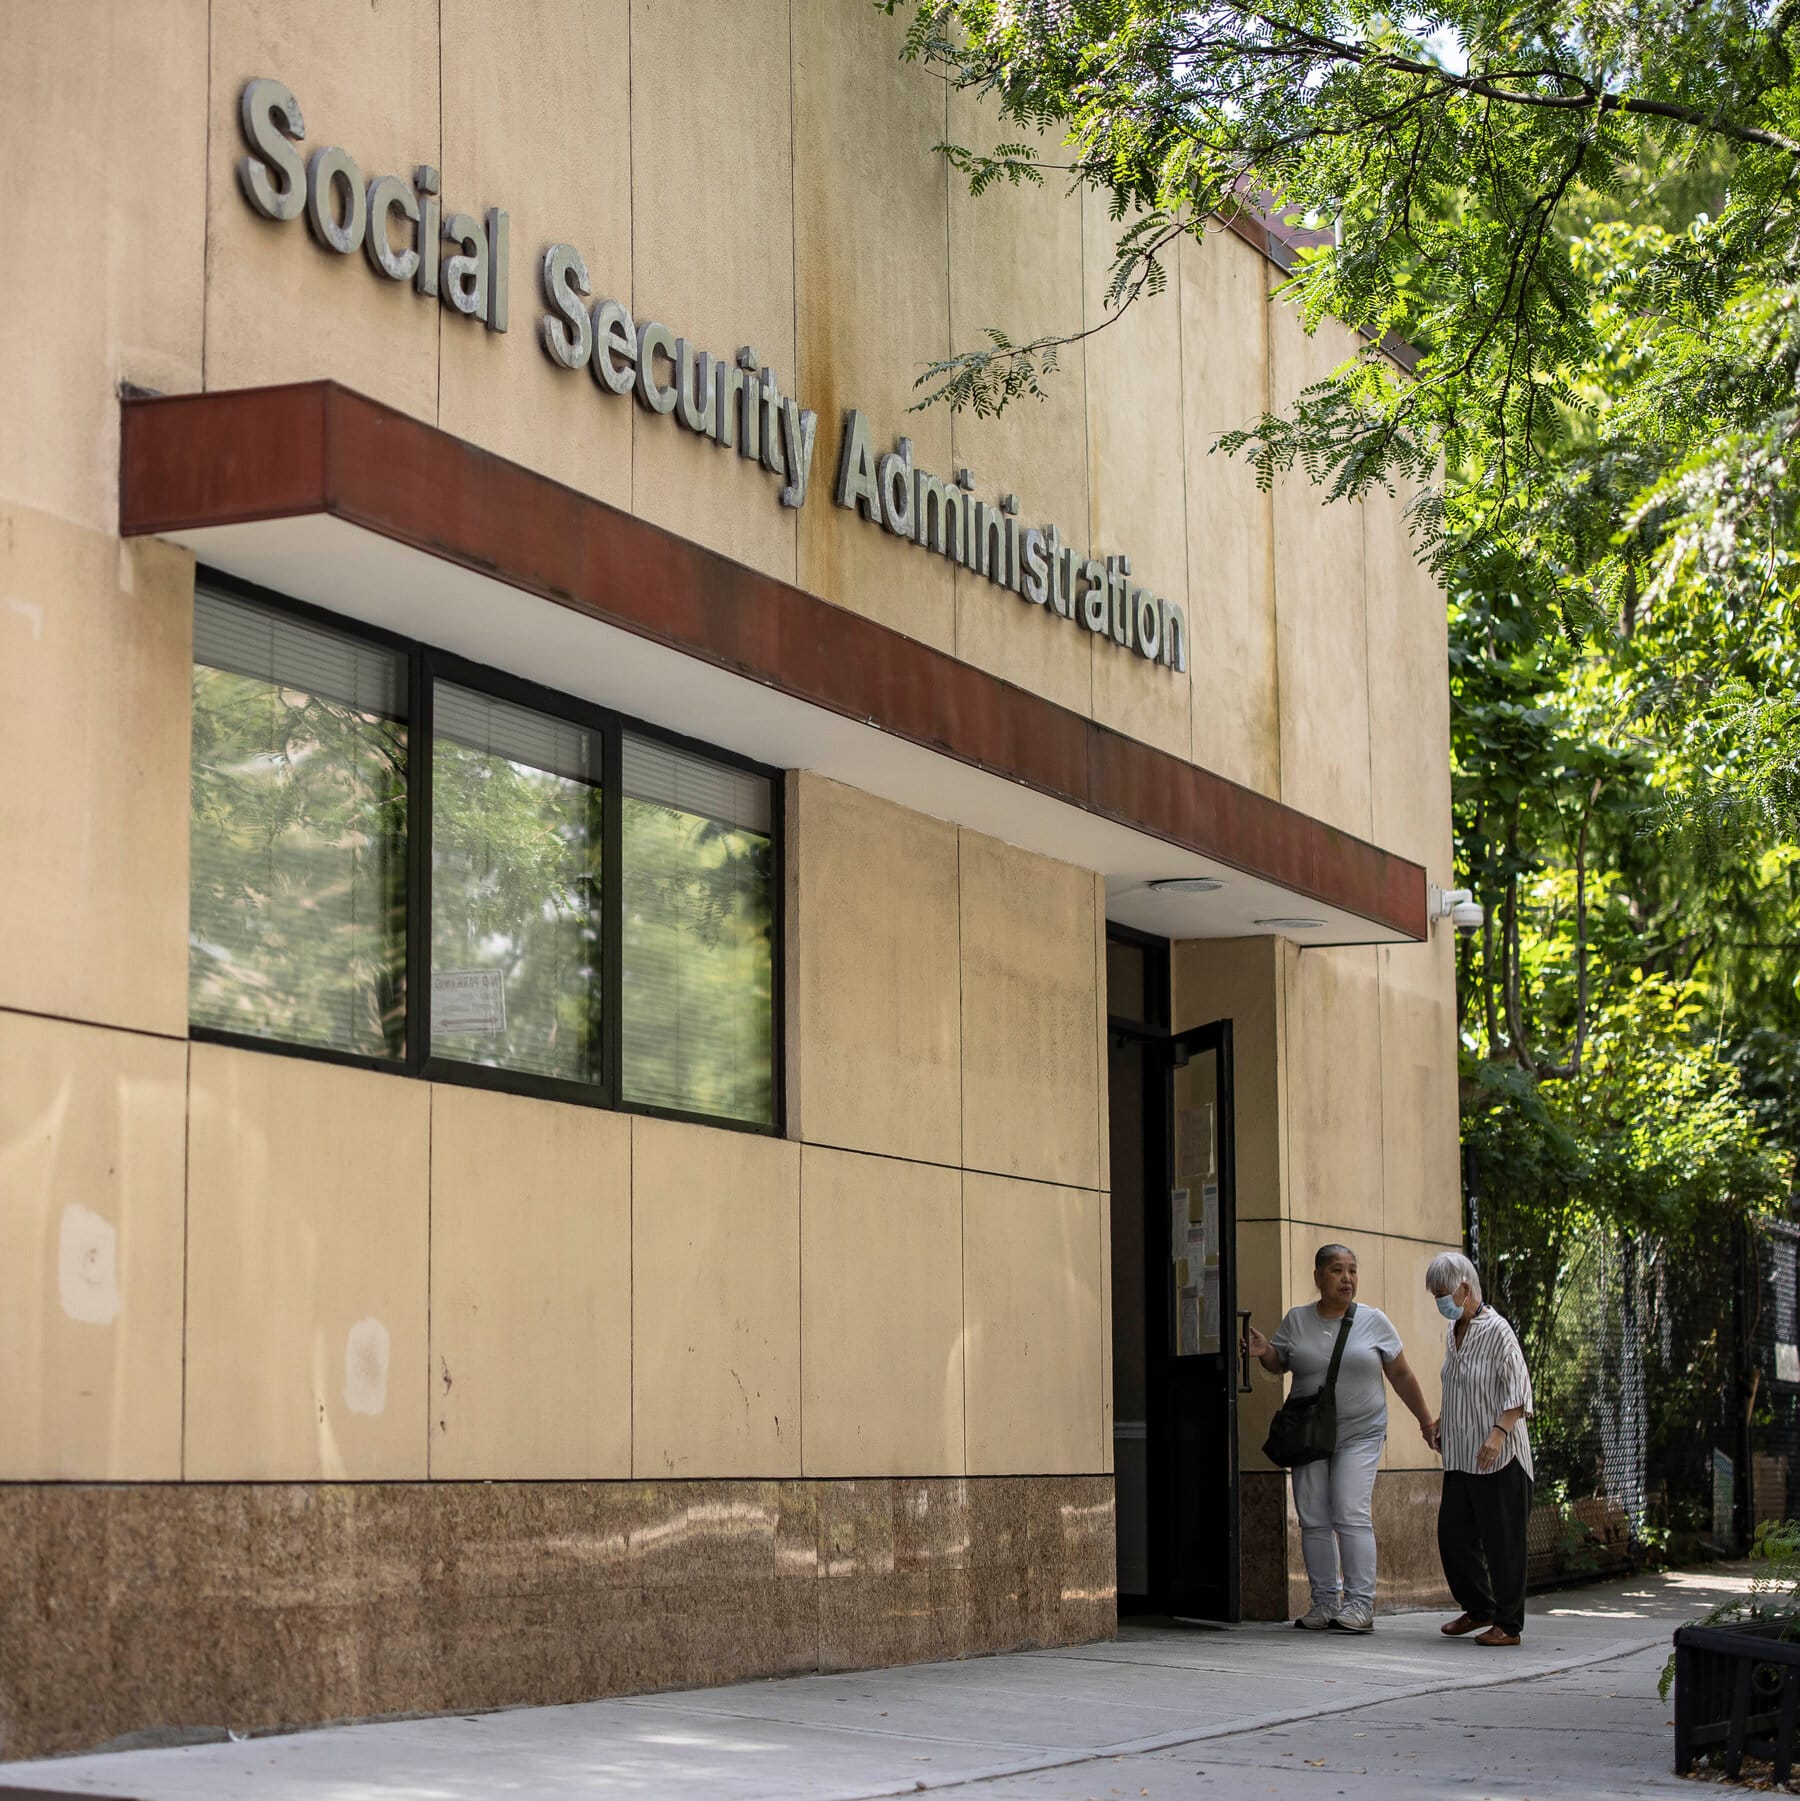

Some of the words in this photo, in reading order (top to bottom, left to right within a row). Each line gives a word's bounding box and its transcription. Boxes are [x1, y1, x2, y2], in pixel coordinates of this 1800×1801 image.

[240, 78, 510, 334] Social
[543, 243, 818, 509] Security
[836, 409, 1187, 673] Administration
